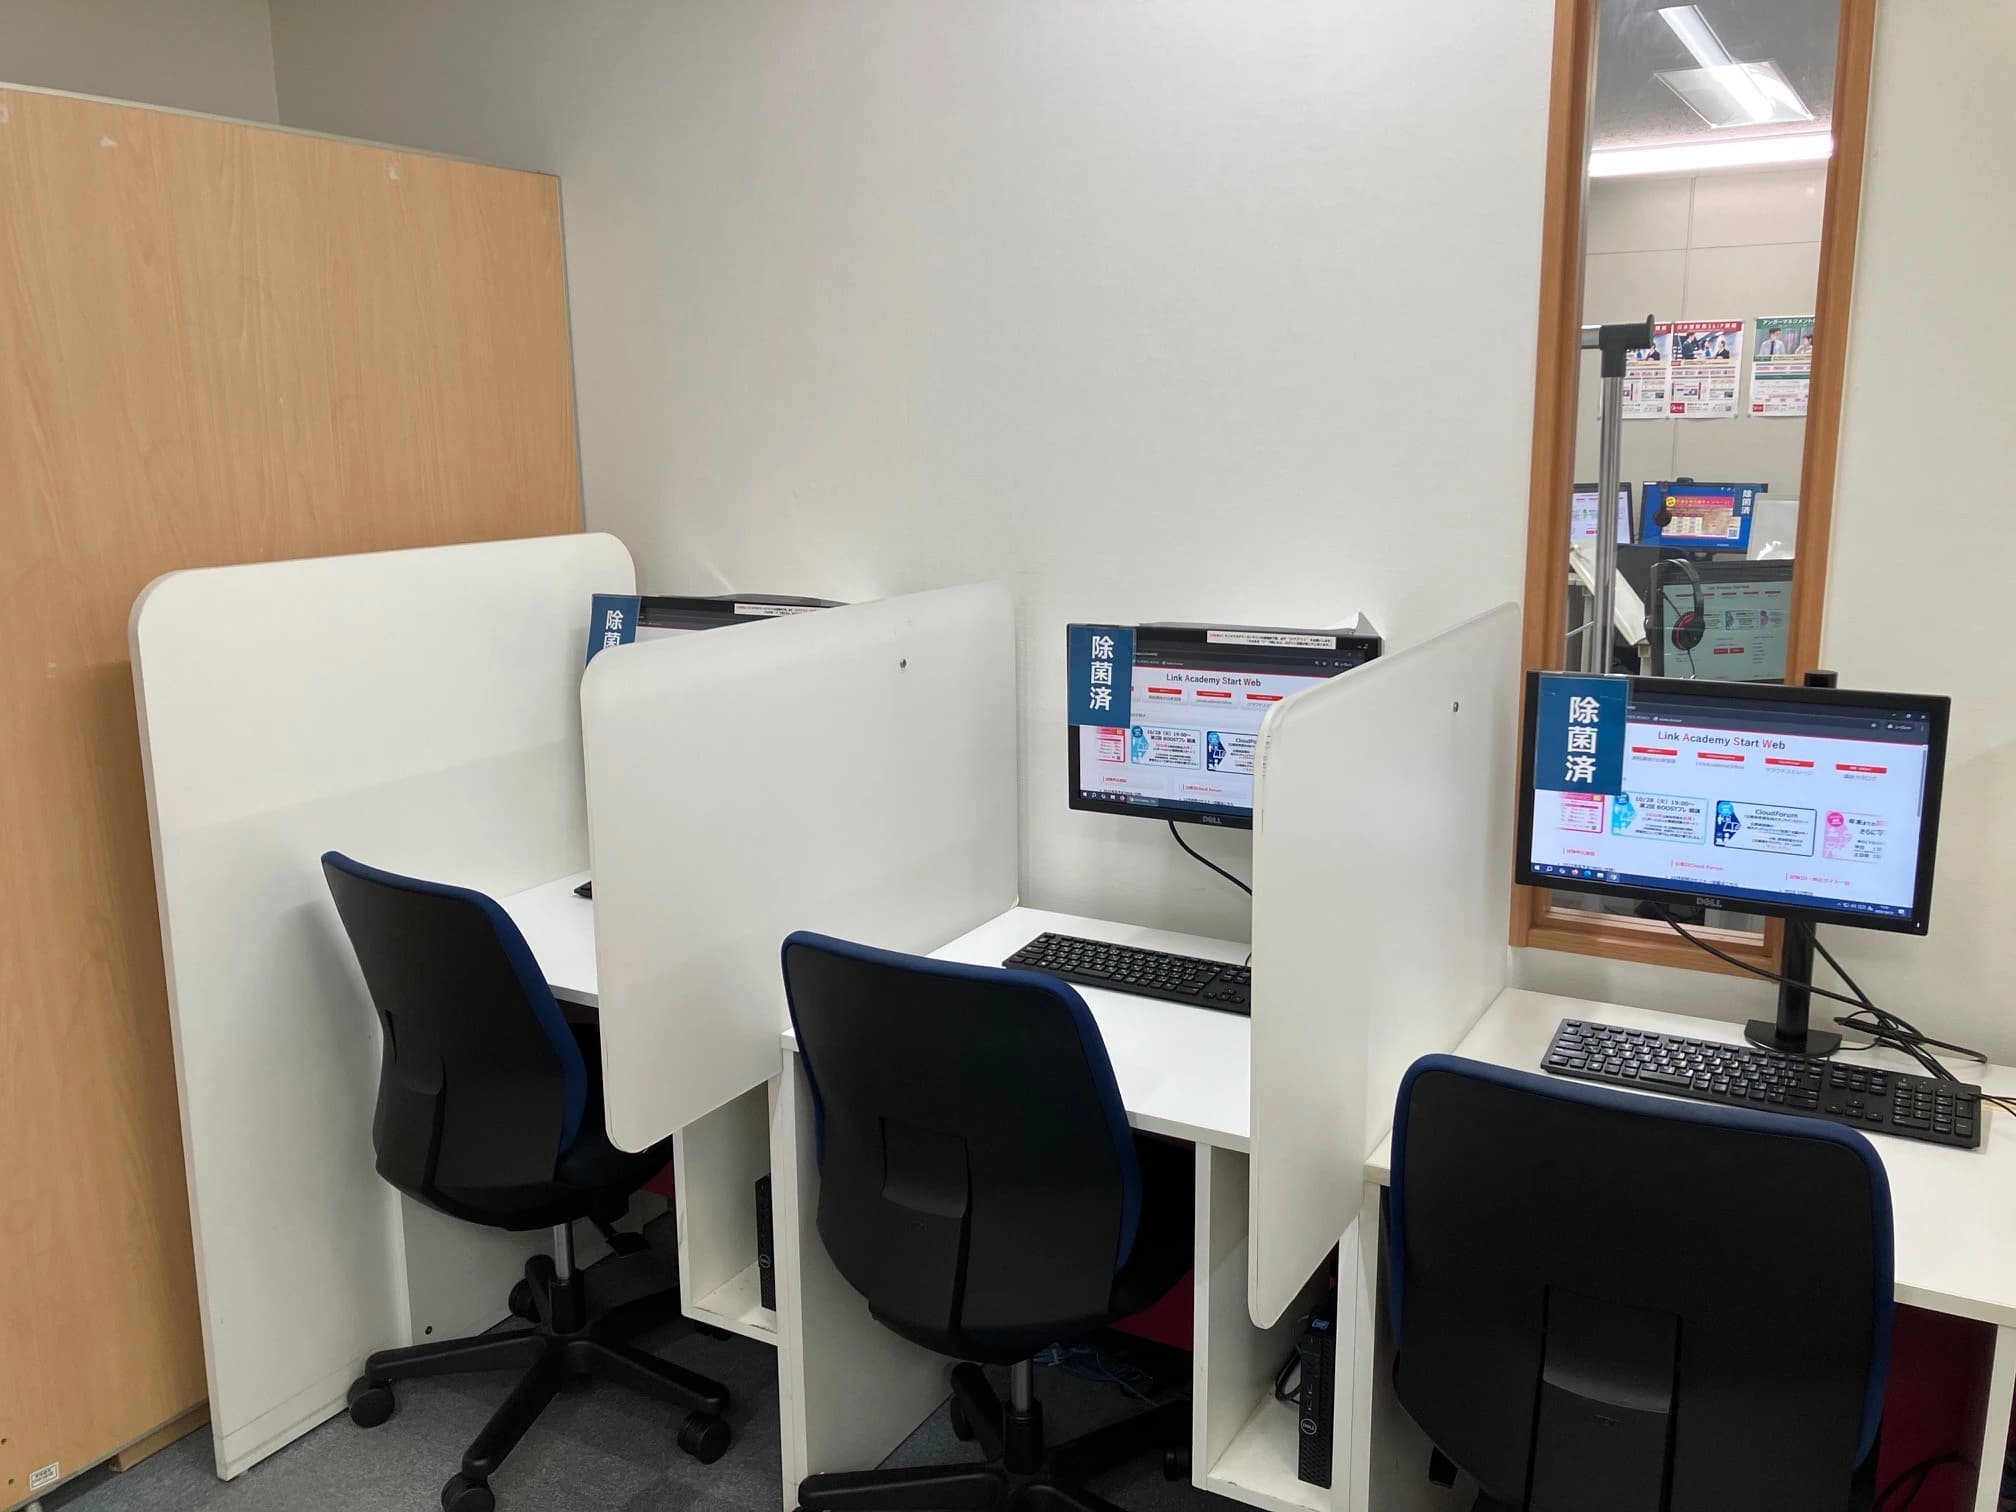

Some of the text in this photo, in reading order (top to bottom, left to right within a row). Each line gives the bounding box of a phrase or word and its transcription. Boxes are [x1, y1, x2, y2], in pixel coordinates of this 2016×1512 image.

[1089, 635, 1115, 711] 除菌済
[1166, 673, 1261, 687] Link Academy Start Web
[1565, 696, 1600, 784] 除菌済
[1658, 730, 1786, 750] Link Academy Start Web
[1202, 814, 1222, 825] DELL
[1754, 808, 1799, 819] CloudForum
[1696, 896, 1723, 909] DELL
